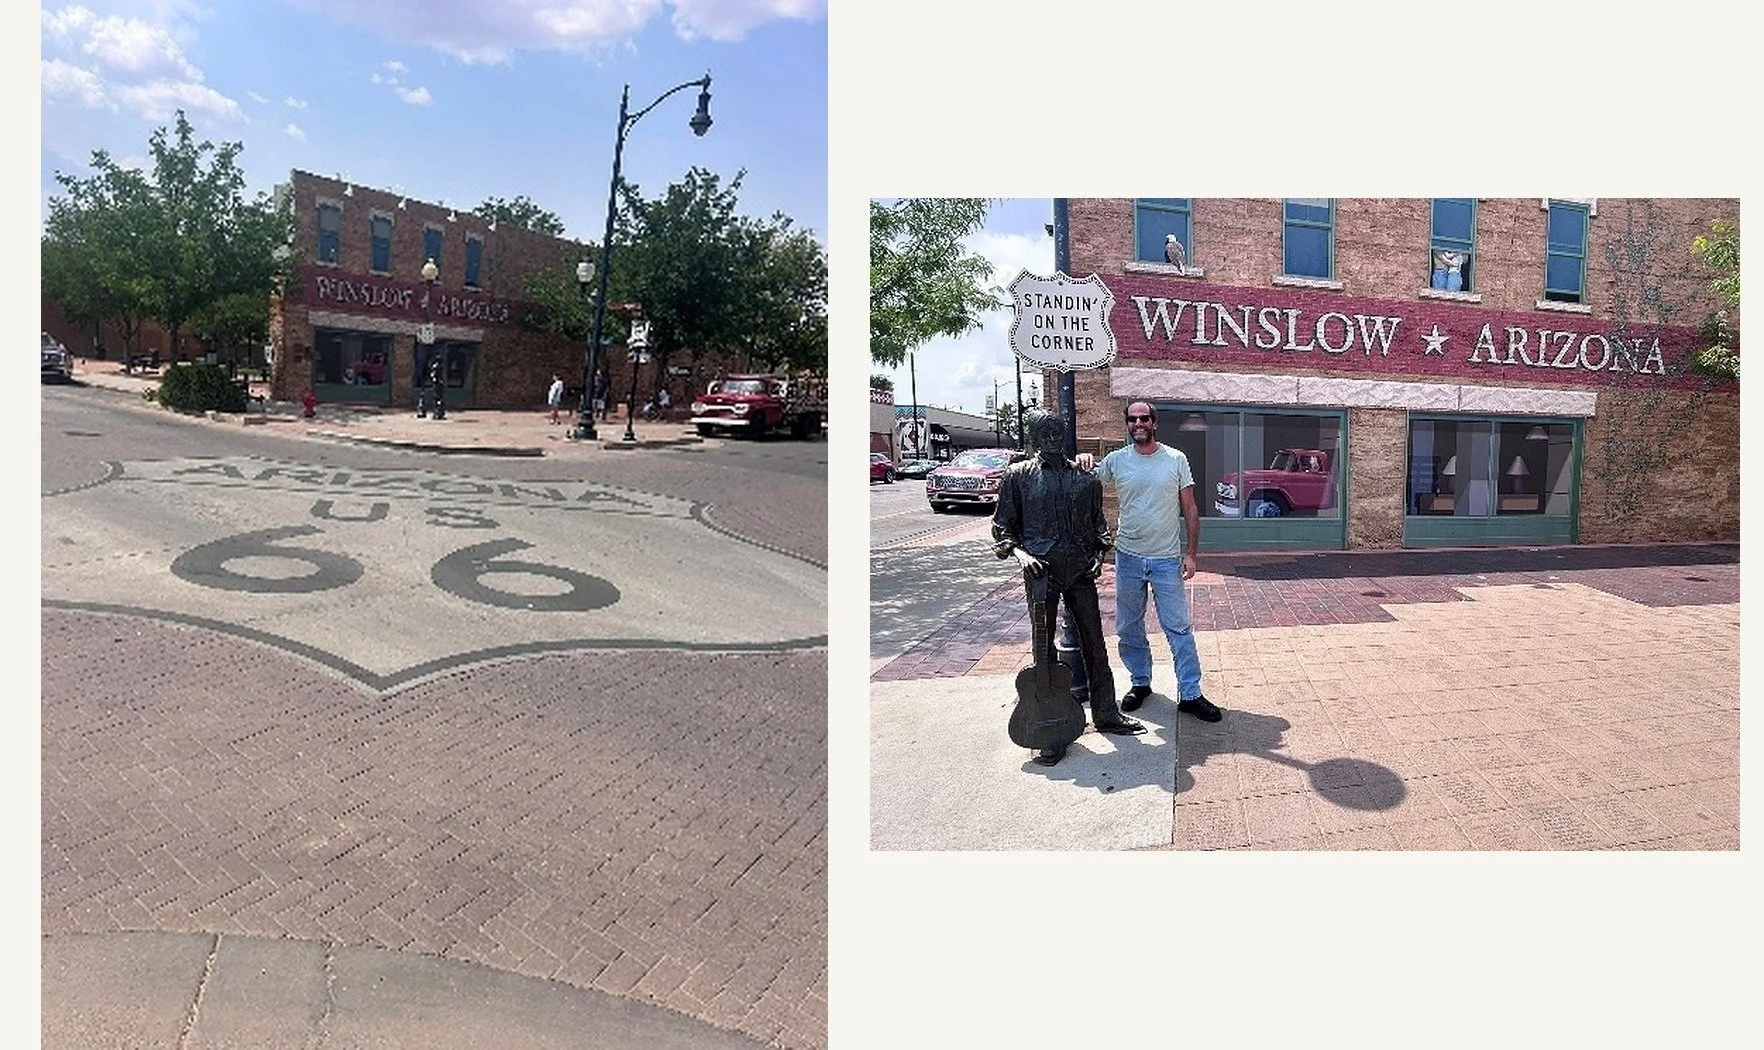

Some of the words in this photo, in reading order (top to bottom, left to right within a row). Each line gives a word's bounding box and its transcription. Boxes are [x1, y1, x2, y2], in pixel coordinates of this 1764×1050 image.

[1024, 293, 1098, 312] STANDIN'
[1034, 314, 1055, 329] ON
[1061, 315, 1090, 332] THE
[1031, 334, 1095, 351] CORNER
[1130, 294, 1403, 357] WINSLOW
[1467, 322, 1667, 375] ARIZONA
[172, 463, 654, 509] ARIZONA
